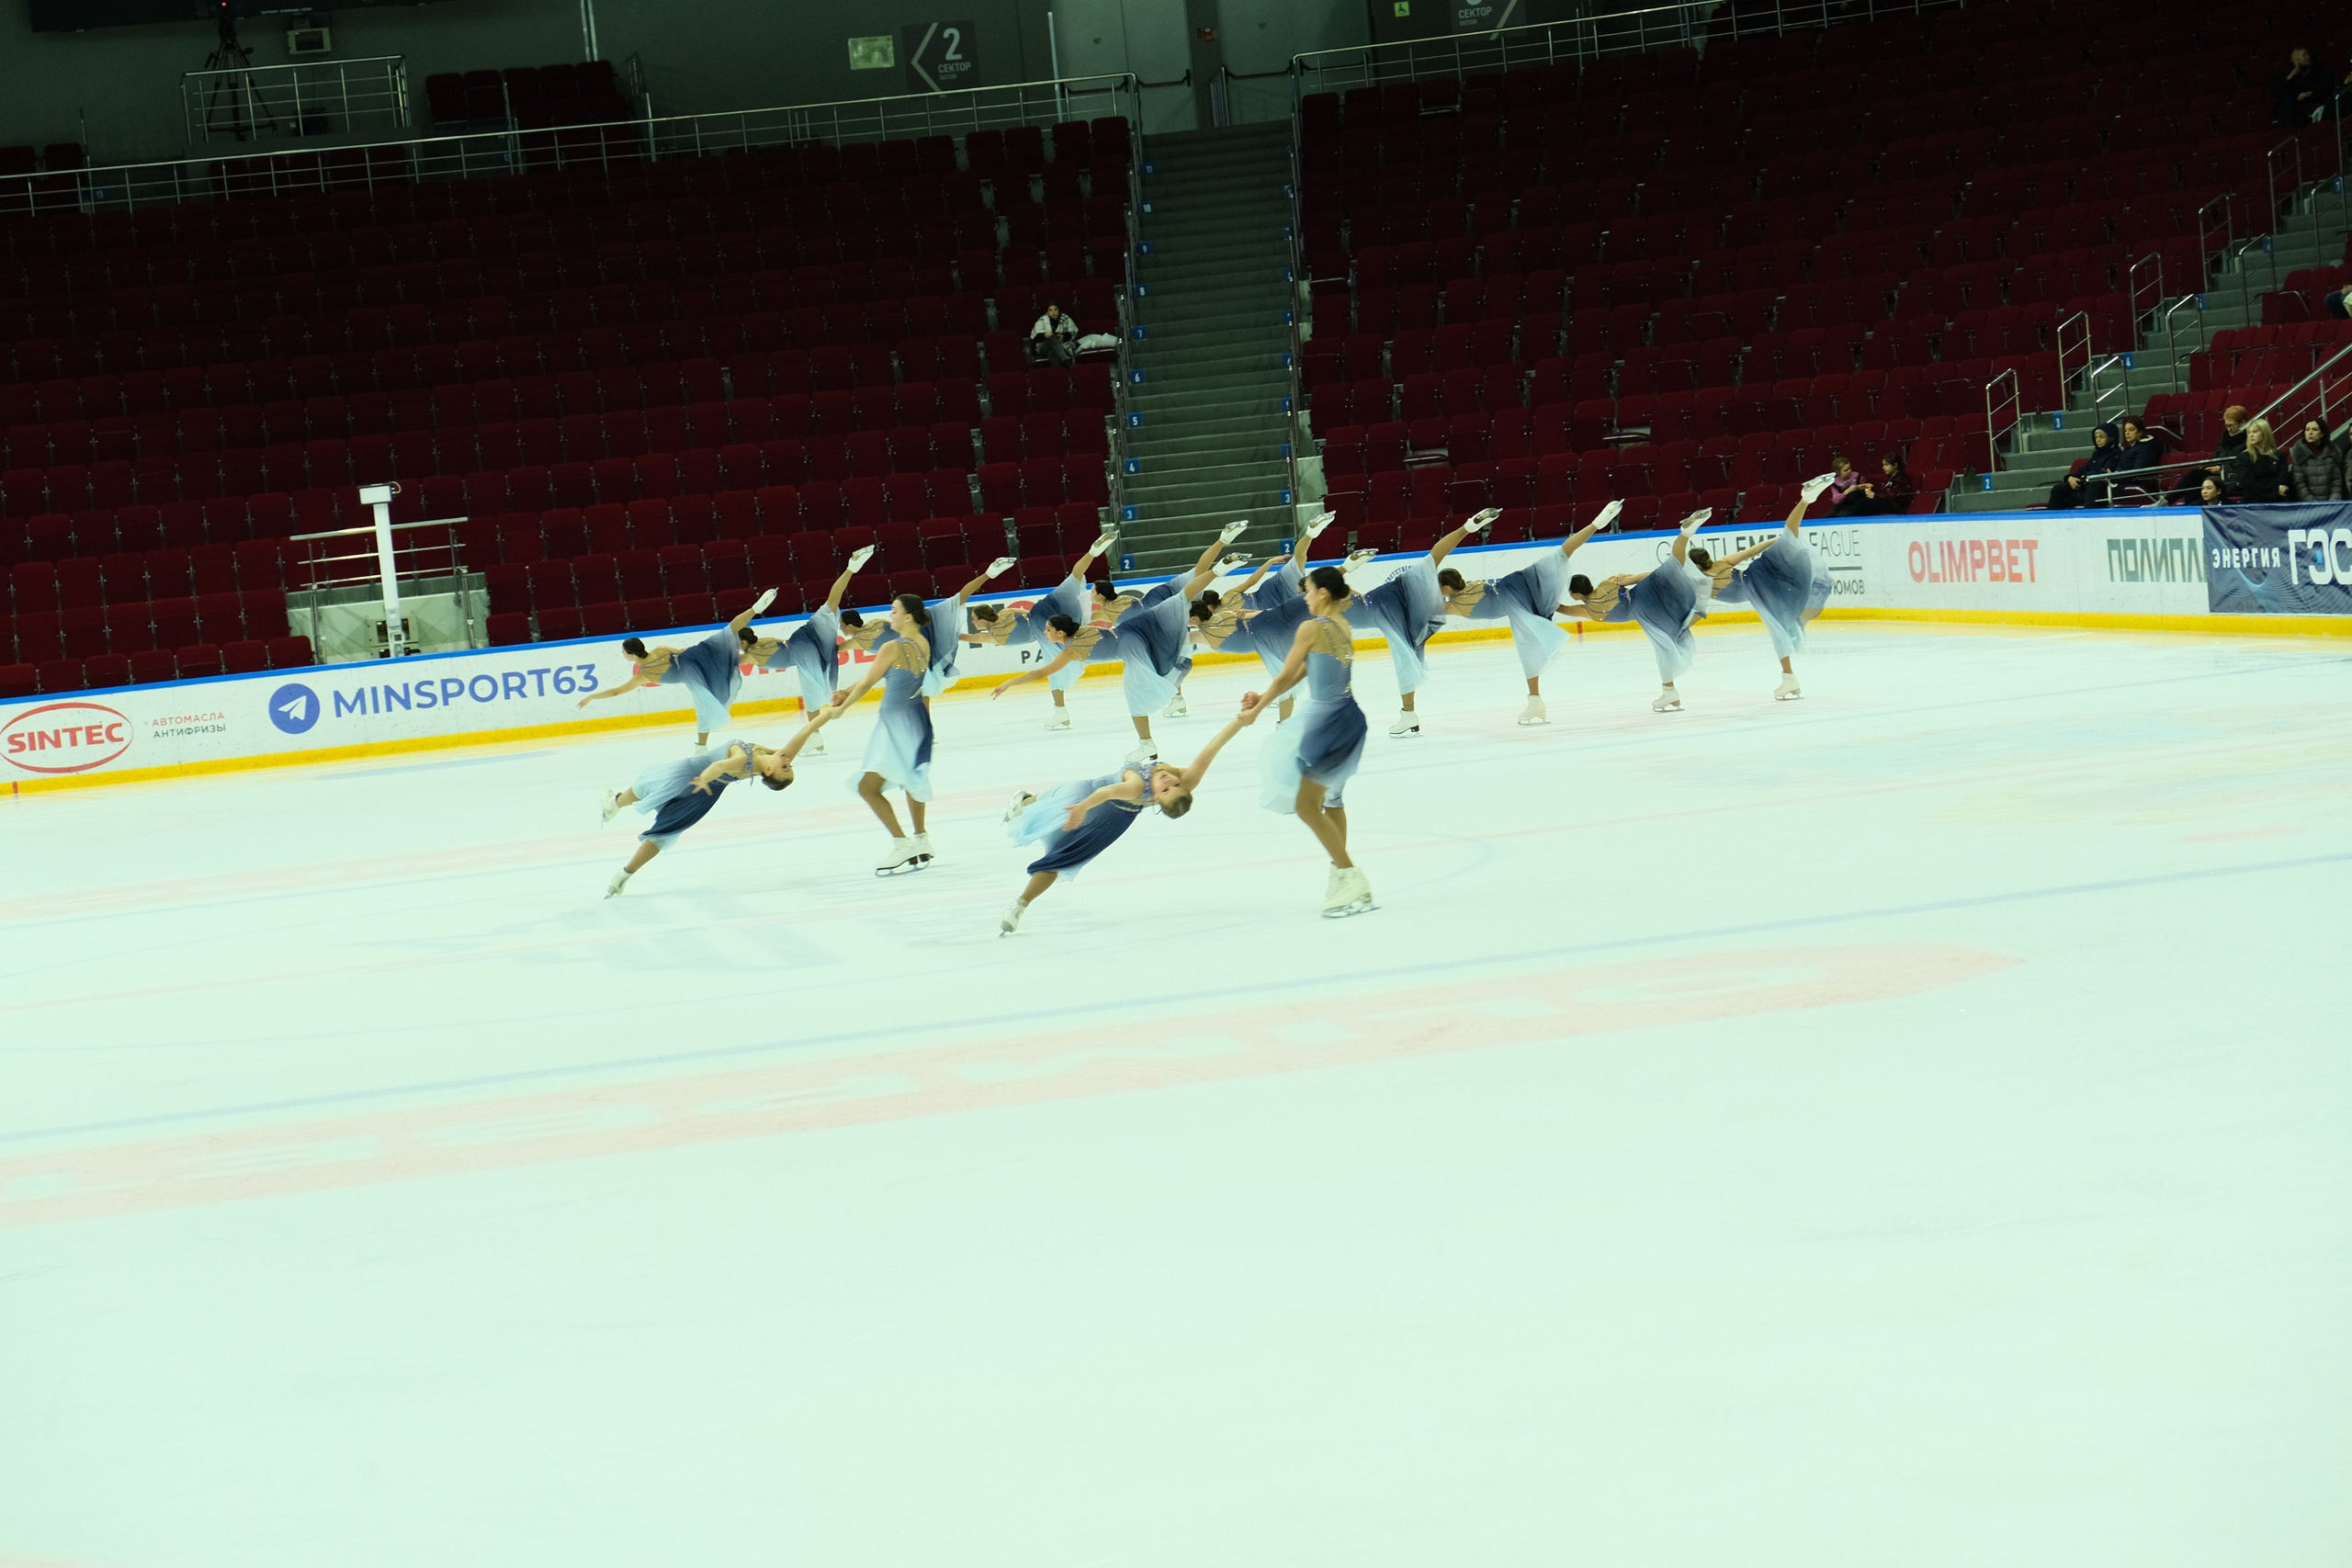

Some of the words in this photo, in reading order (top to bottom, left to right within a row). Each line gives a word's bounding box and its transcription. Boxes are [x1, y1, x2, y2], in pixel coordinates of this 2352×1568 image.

[1458, 6, 1492, 19] СЕКТОР
[943, 28, 963, 61] 2
[938, 62, 971, 73] СЕКТОР
[1142, 244, 1148, 254] 9
[1139, 287, 1146, 296] 8
[1136, 329, 1143, 338] 7
[2125, 356, 2132, 367] 4
[1135, 373, 1140, 382] 6
[1132, 416, 1137, 426] 5
[2055, 417, 2061, 428] 3
[1129, 462, 1136, 472] 4
[1984, 478, 1991, 490] 2
[1284, 493, 1291, 503] 3
[1126, 510, 1133, 519] 3
[1284, 543, 1291, 553] 2
[1808, 530, 1861, 557] EAGUE
[1907, 539, 2039, 583] OLIMPBET
[2107, 537, 2207, 583] ПОЛИПЛ
[2212, 547, 2280, 569] ЭНЕРГИЯ
[2288, 528, 2352, 585] ГЭС
[1124, 559, 1130, 570] 2
[333, 663, 599, 718] MINSPORT63
[152, 712, 225, 727] АВТОМАСЛА
[153, 724, 226, 739] АНТИФРИЗЫ
[6, 722, 124, 753] SINTEC
